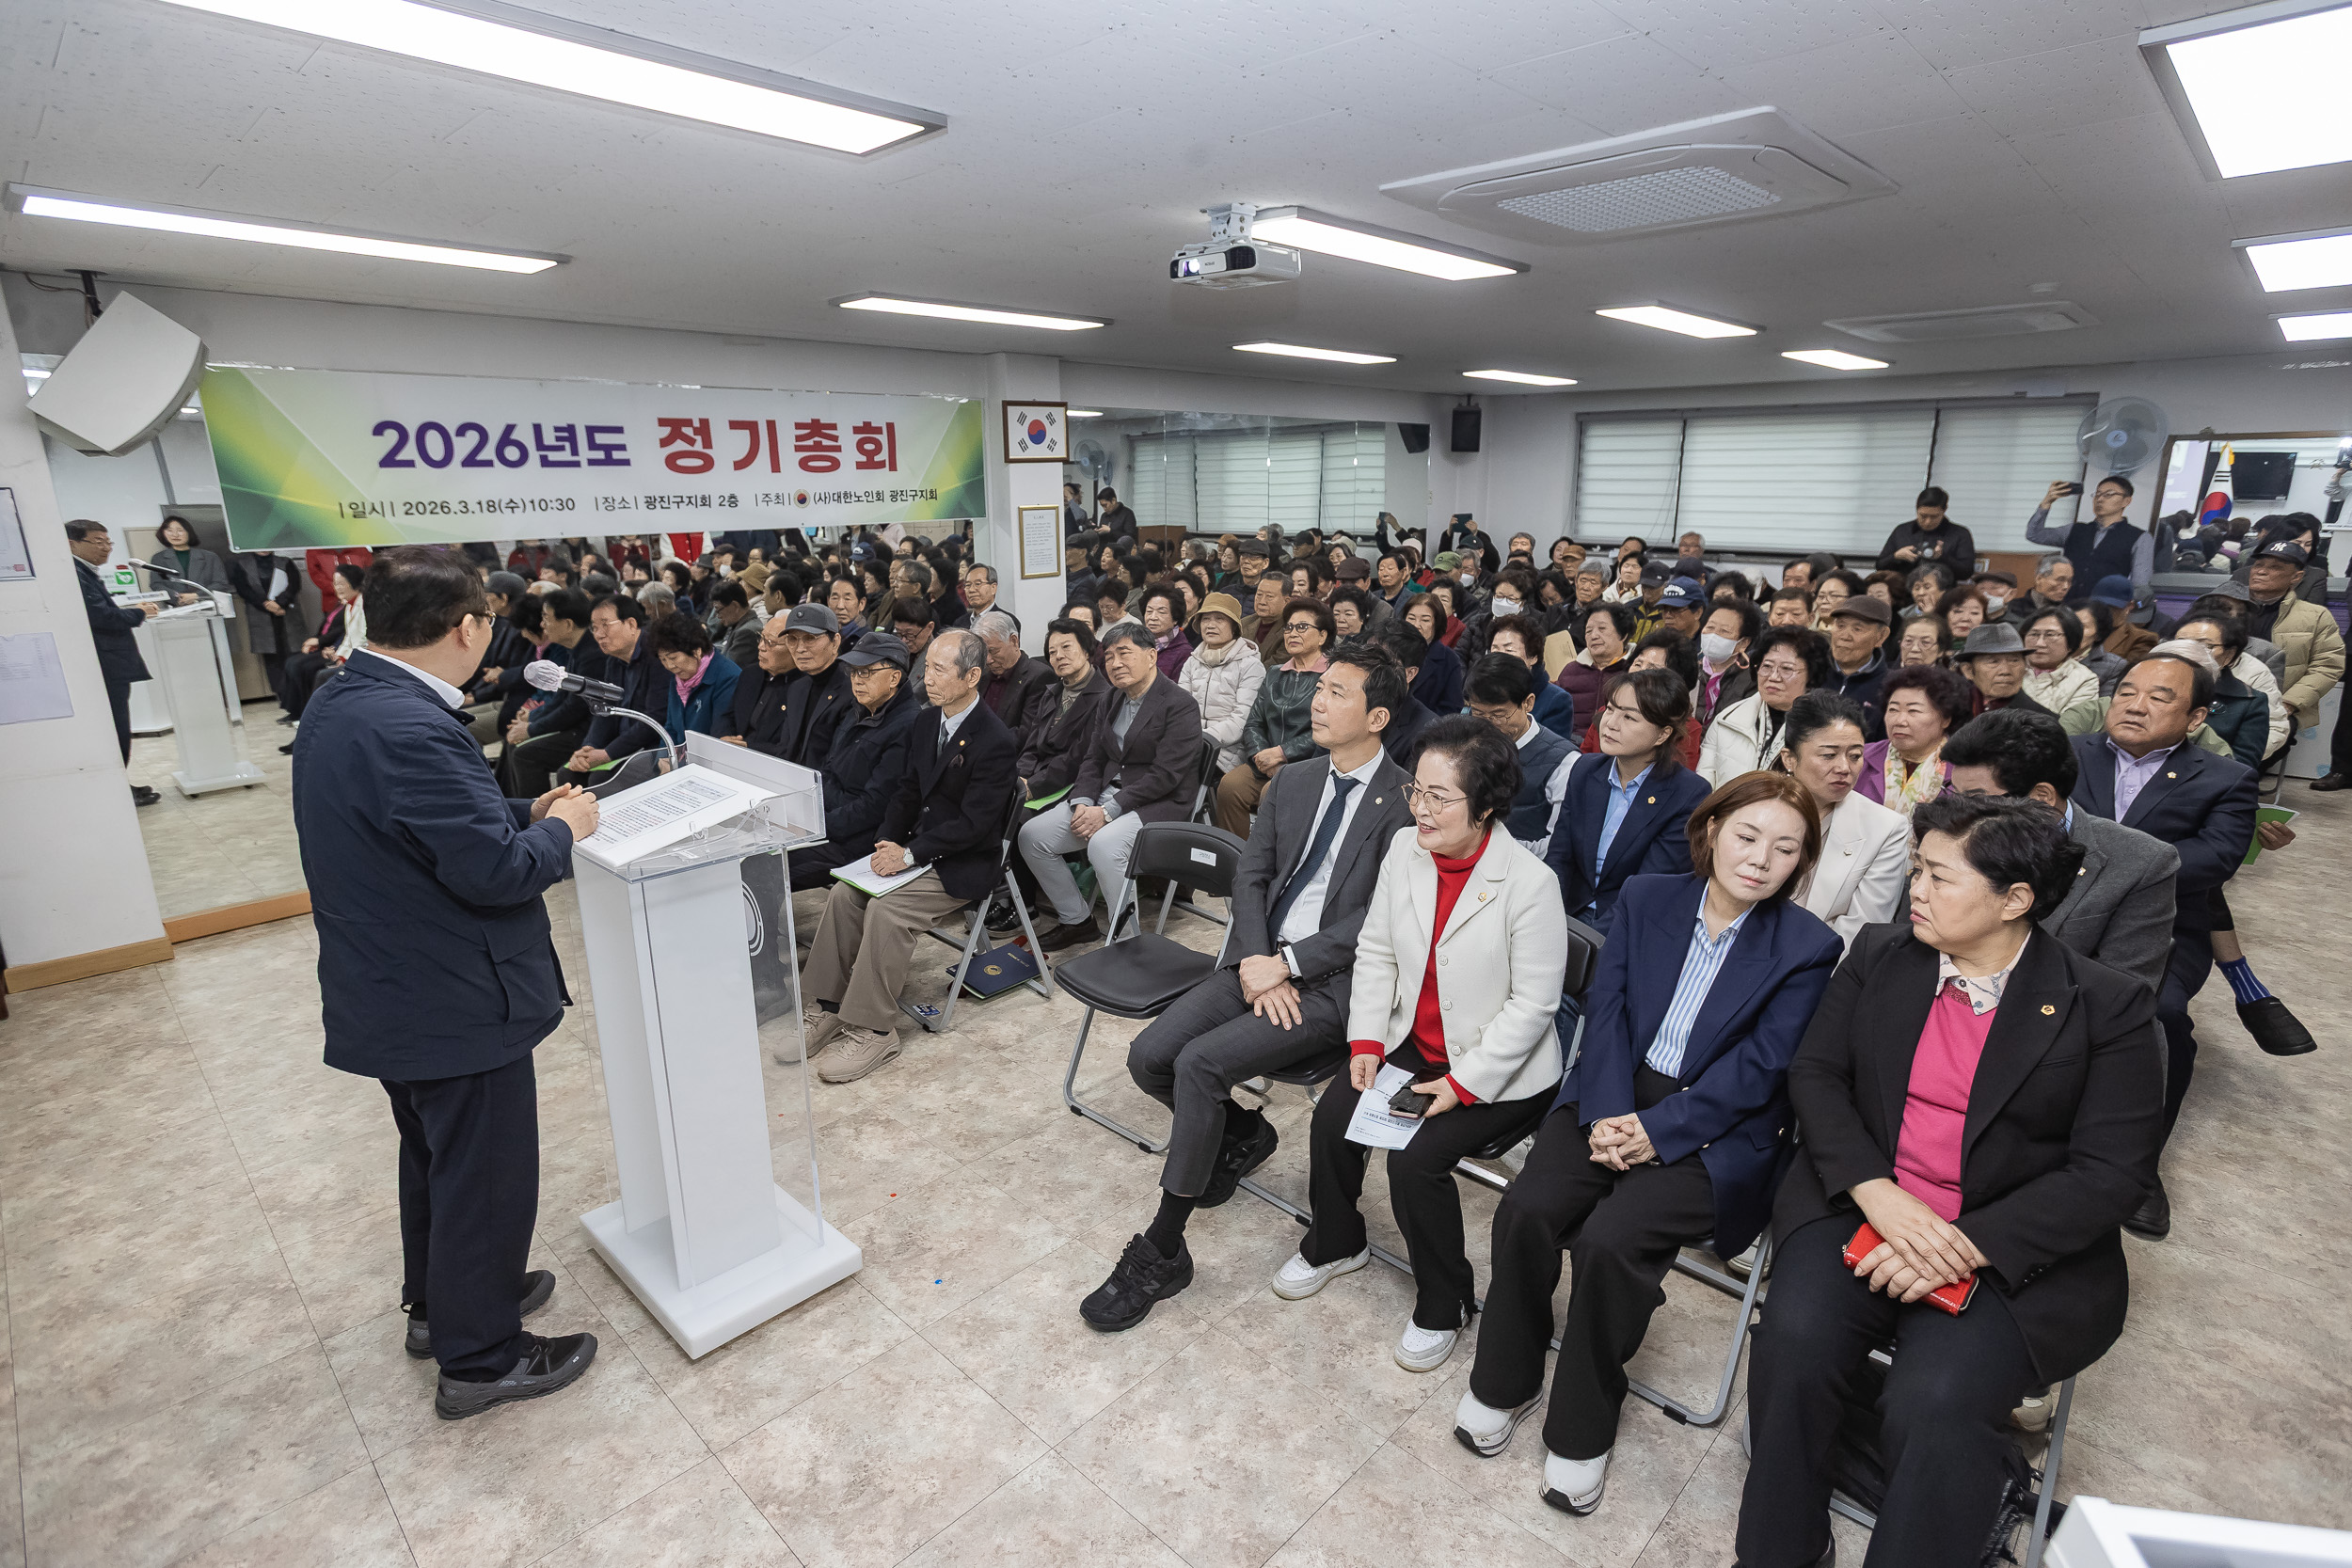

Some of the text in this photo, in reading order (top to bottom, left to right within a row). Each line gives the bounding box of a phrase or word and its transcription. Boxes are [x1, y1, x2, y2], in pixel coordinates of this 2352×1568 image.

[373, 418, 898, 474] 2026년도 정기총회
[644, 494, 711, 510] 광진구지회
[718, 493, 739, 508] 2층
[813, 490, 885, 505] (사)대한노인회
[889, 488, 938, 502] 광진구지회
